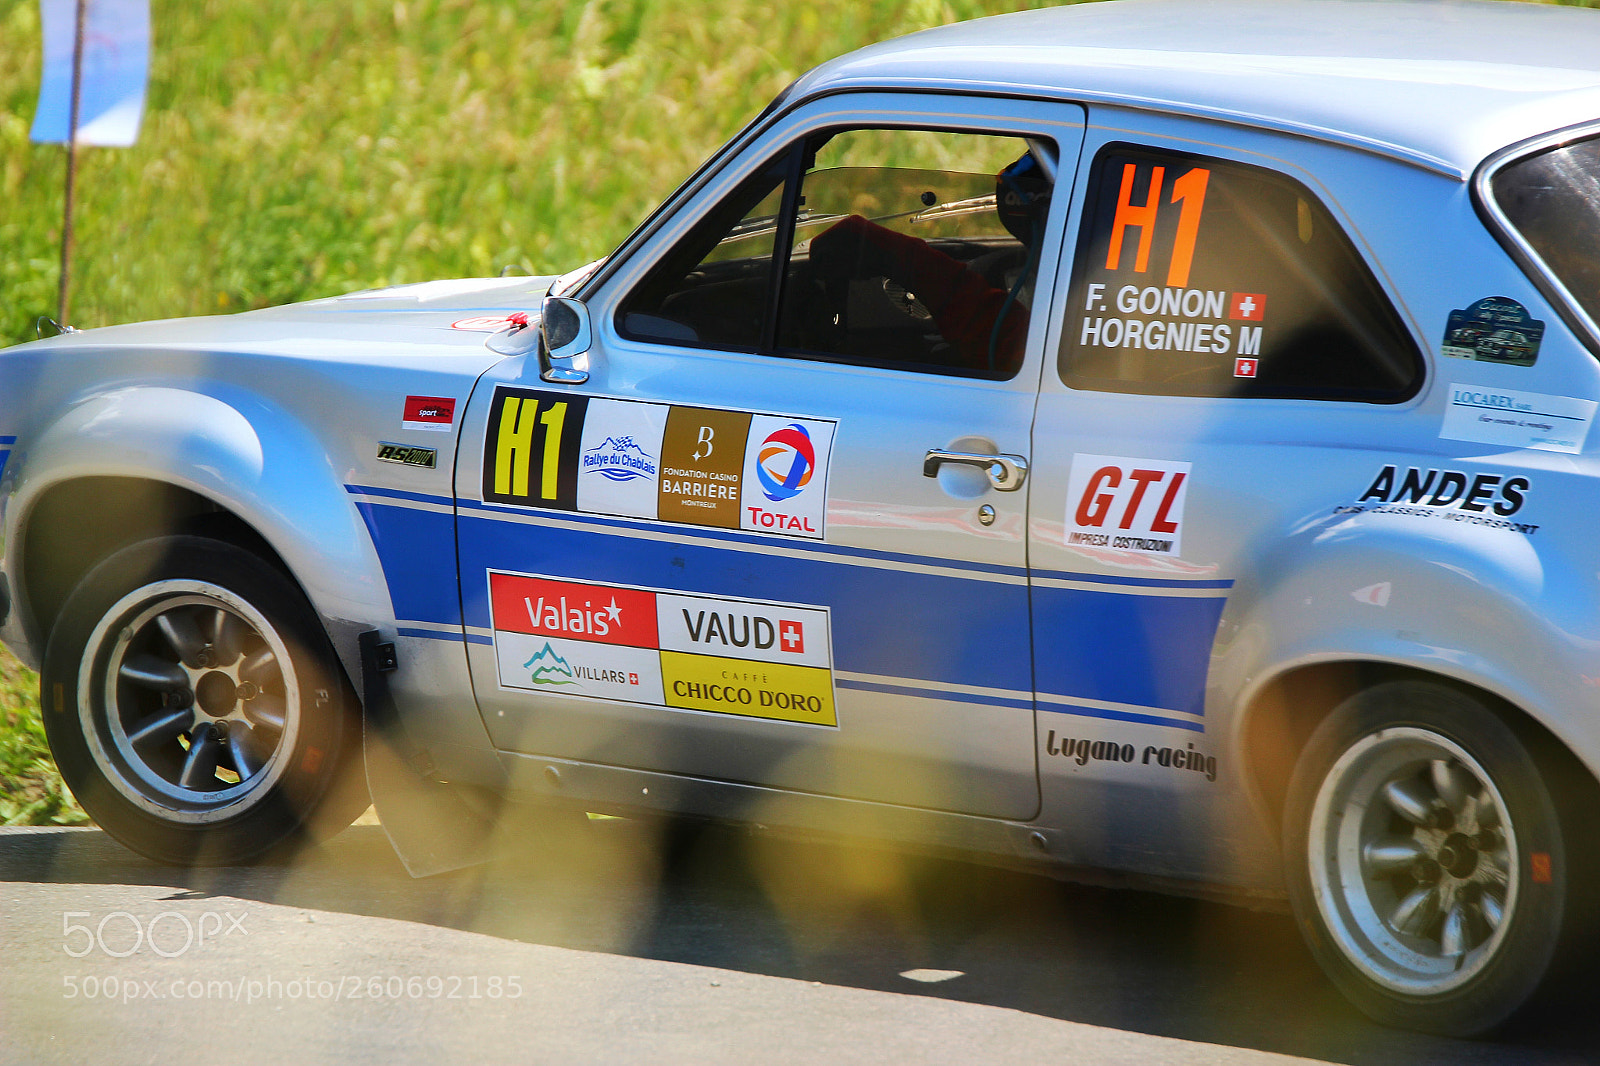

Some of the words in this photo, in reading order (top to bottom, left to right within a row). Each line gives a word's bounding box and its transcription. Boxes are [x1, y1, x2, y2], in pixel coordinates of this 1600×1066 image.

[1105, 163, 1211, 288] H1
[1085, 283, 1107, 312] F.
[1116, 285, 1226, 319] GONON
[1080, 316, 1232, 354] HORGNIES
[1237, 326, 1263, 356] M
[418, 409, 438, 418] sport
[494, 396, 568, 500] H1
[584, 453, 609, 467] Rallye
[610, 453, 620, 465] du
[622, 453, 656, 475] Chablais
[663, 467, 708, 479] FONDATION
[709, 472, 738, 482] CASINO
[662, 480, 738, 500] BARRIÈRE
[681, 500, 717, 509] MONTREUX
[1075, 465, 1187, 534] GTL
[1357, 465, 1530, 517] ANDES
[747, 506, 816, 533] TOTAL
[1443, 512, 1540, 535] MOTORSPORT
[1068, 531, 1110, 546] IMPRESA
[1112, 536, 1174, 553] COSTRUZIONI
[524, 596, 609, 636] Valais
[682, 608, 775, 650] VAUD
[573, 665, 626, 685] VILLARS
[721, 670, 768, 684] CAFFÈ
[673, 680, 752, 705] CHICCO
[759, 690, 822, 713] D'ORO
[1046, 729, 1136, 767] Lugano
[1141, 742, 1217, 783] racing
